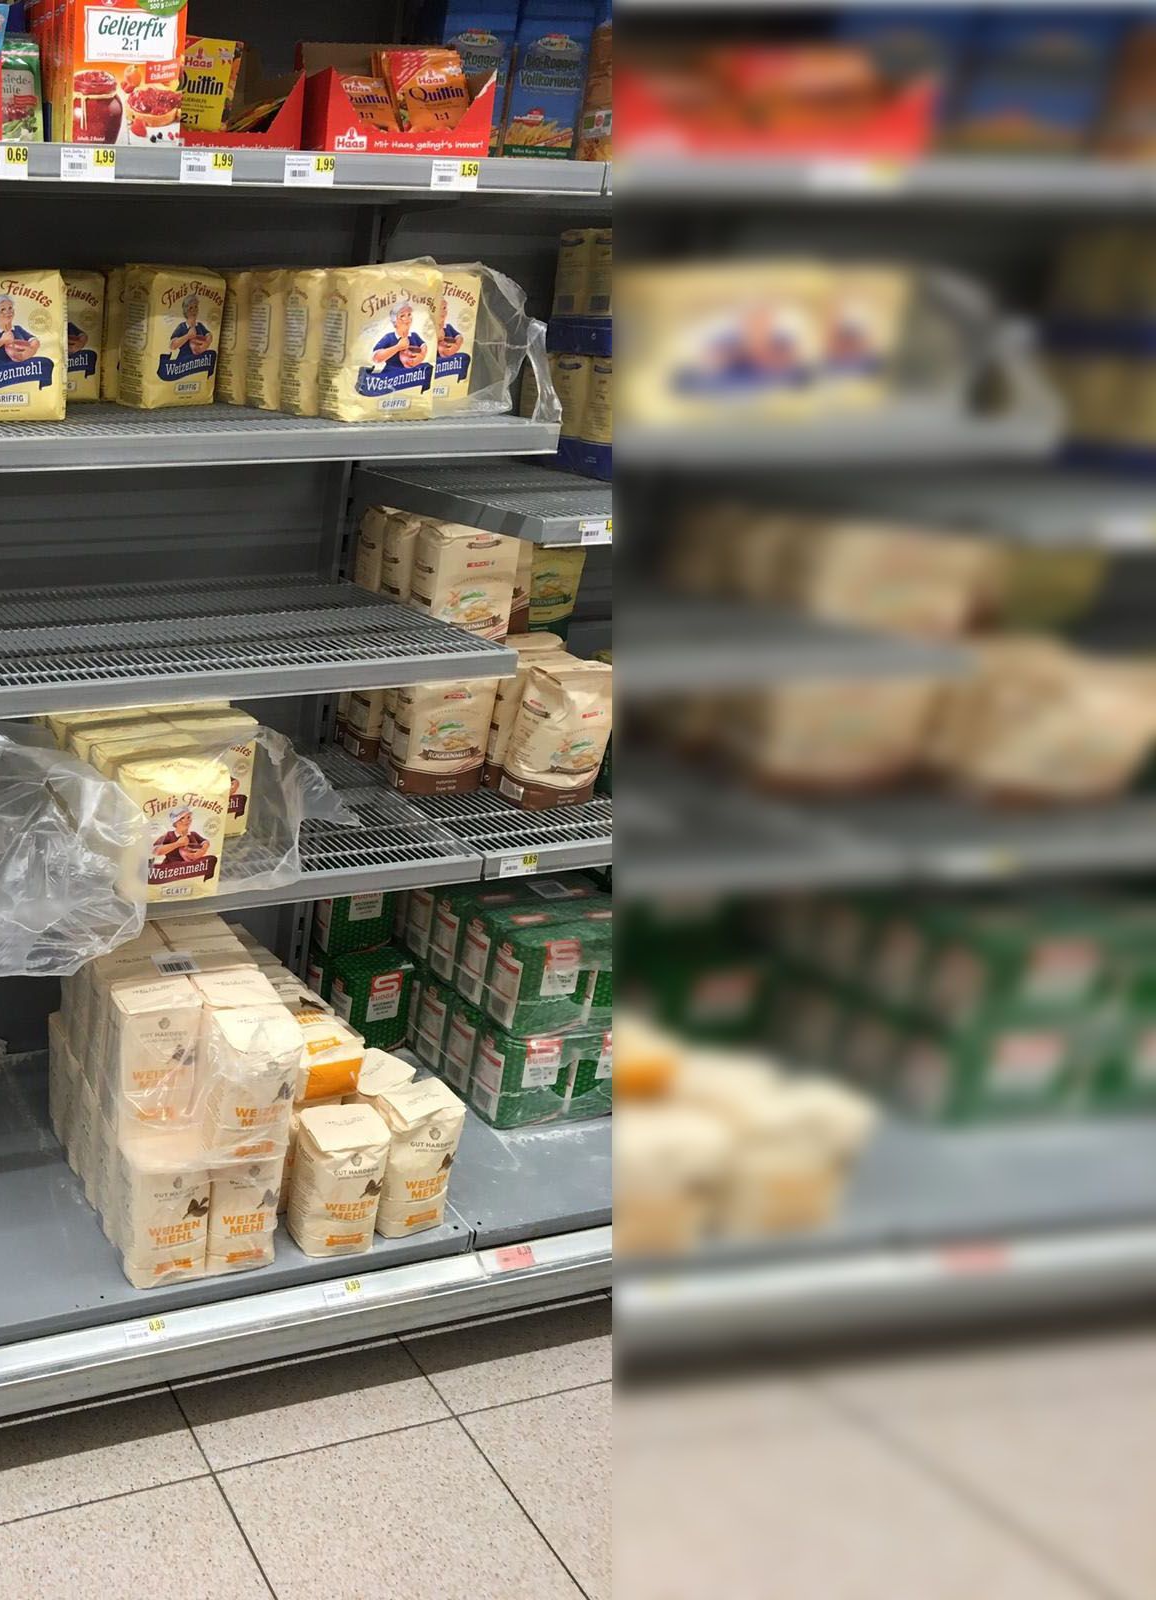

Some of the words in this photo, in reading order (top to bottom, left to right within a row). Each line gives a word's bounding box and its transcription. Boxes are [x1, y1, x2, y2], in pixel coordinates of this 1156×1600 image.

[98, 15, 167, 40] Gelierfix
[121, 37, 140, 51] 2:1
[185, 56, 213, 68] Haas
[418, 76, 445, 86] Haas
[359, 111, 374, 120] 1:1
[434, 111, 450, 121] 1:1
[336, 137, 365, 149] Haas
[374, 139, 390, 148] Mit
[392, 140, 414, 149] Haas
[416, 139, 453, 151] gelingt's
[455, 140, 484, 149] immer!
[7, 146, 28, 163] 0,69
[95, 149, 115, 165] 1,99
[213, 153, 233, 168] 1,99
[316, 158, 335, 173] 1,99
[461, 163, 479, 177] 1,59
[0, 279, 53, 309] Feinstes
[161, 282, 189, 309] Fini's
[190, 280, 225, 307] Feinstes
[360, 291, 397, 318] Fini's
[165, 353, 212, 377] Weizenmehl
[365, 366, 427, 392] Weizenmehl
[143, 794, 178, 818] Fini's
[182, 791, 224, 816] Feinstes
[147, 859, 209, 881] Weizenmehl
[405, 1173, 447, 1190] WEIZEN
[324, 1199, 376, 1213] WEIZEN
[331, 1211, 366, 1221] MEHL
[148, 1219, 201, 1238] WEIZEN
[156, 1232, 194, 1247] MEHL
